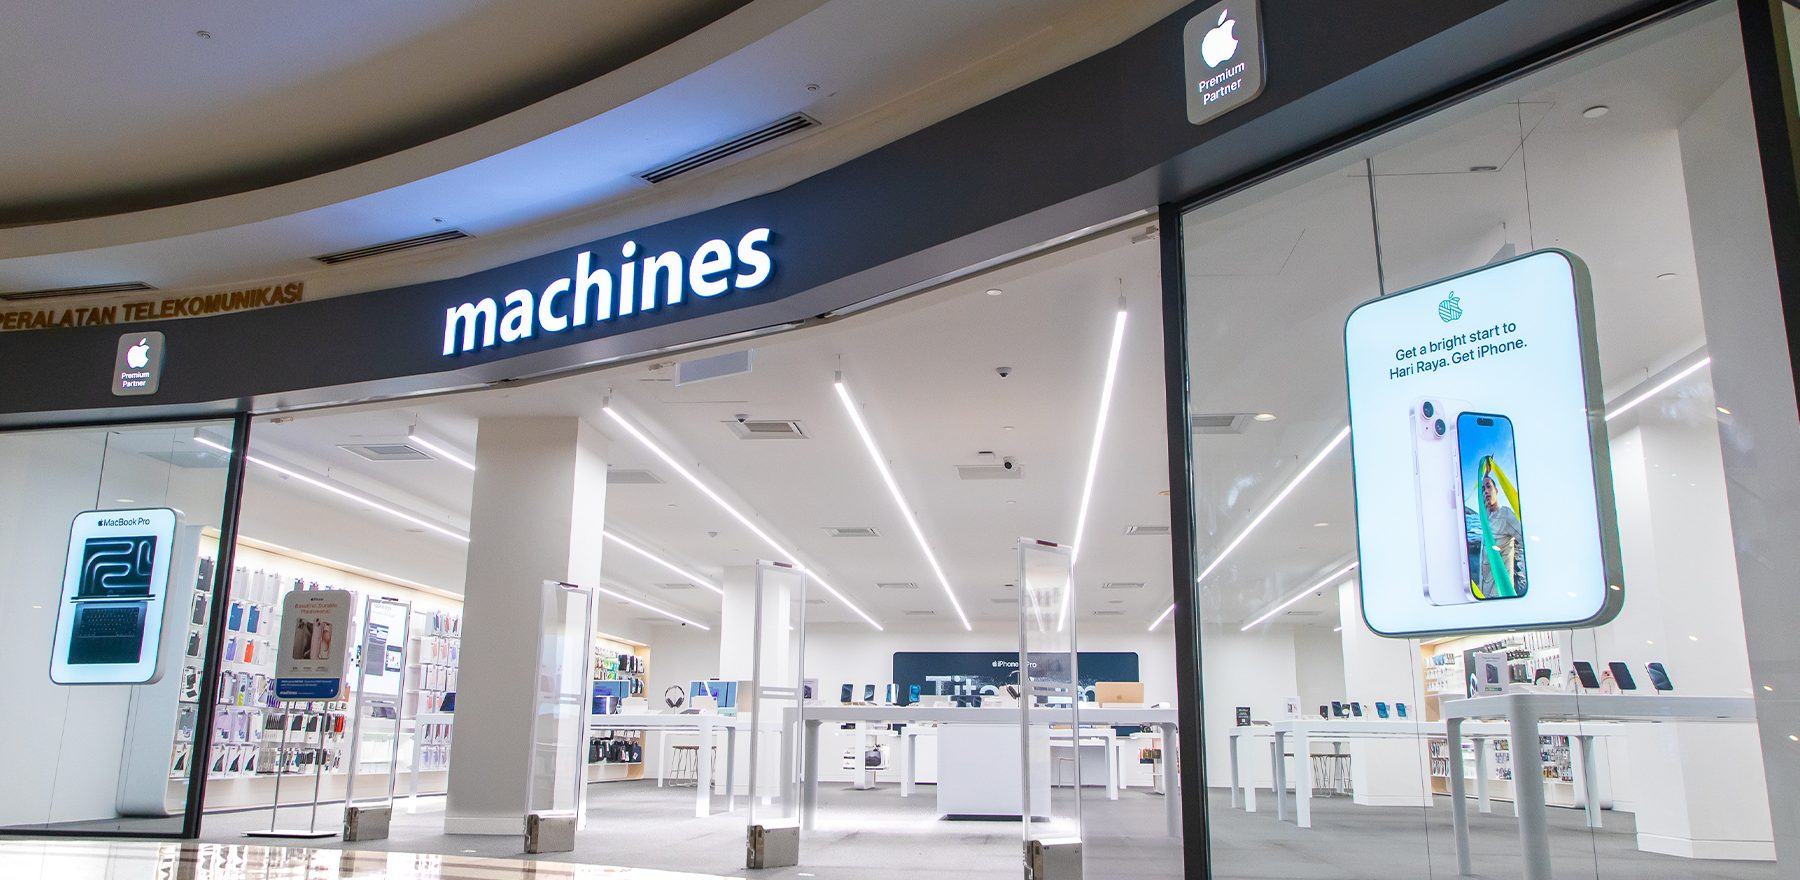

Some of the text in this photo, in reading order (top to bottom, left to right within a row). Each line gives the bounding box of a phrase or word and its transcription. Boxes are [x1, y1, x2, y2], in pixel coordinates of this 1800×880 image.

[1199, 62, 1245, 92] Premium
[1203, 78, 1242, 105] Partner
[122, 282, 304, 321] TELEKOMUNIKASI
[443, 227, 774, 356] machines
[1395, 322, 1516, 361] Get a bright start to
[1389, 338, 1527, 380] Hari Raya. Get iPhone.
[121, 371, 150, 379] Premium
[122, 380, 147, 388] Partner
[103, 517, 150, 526] MacBook Pro
